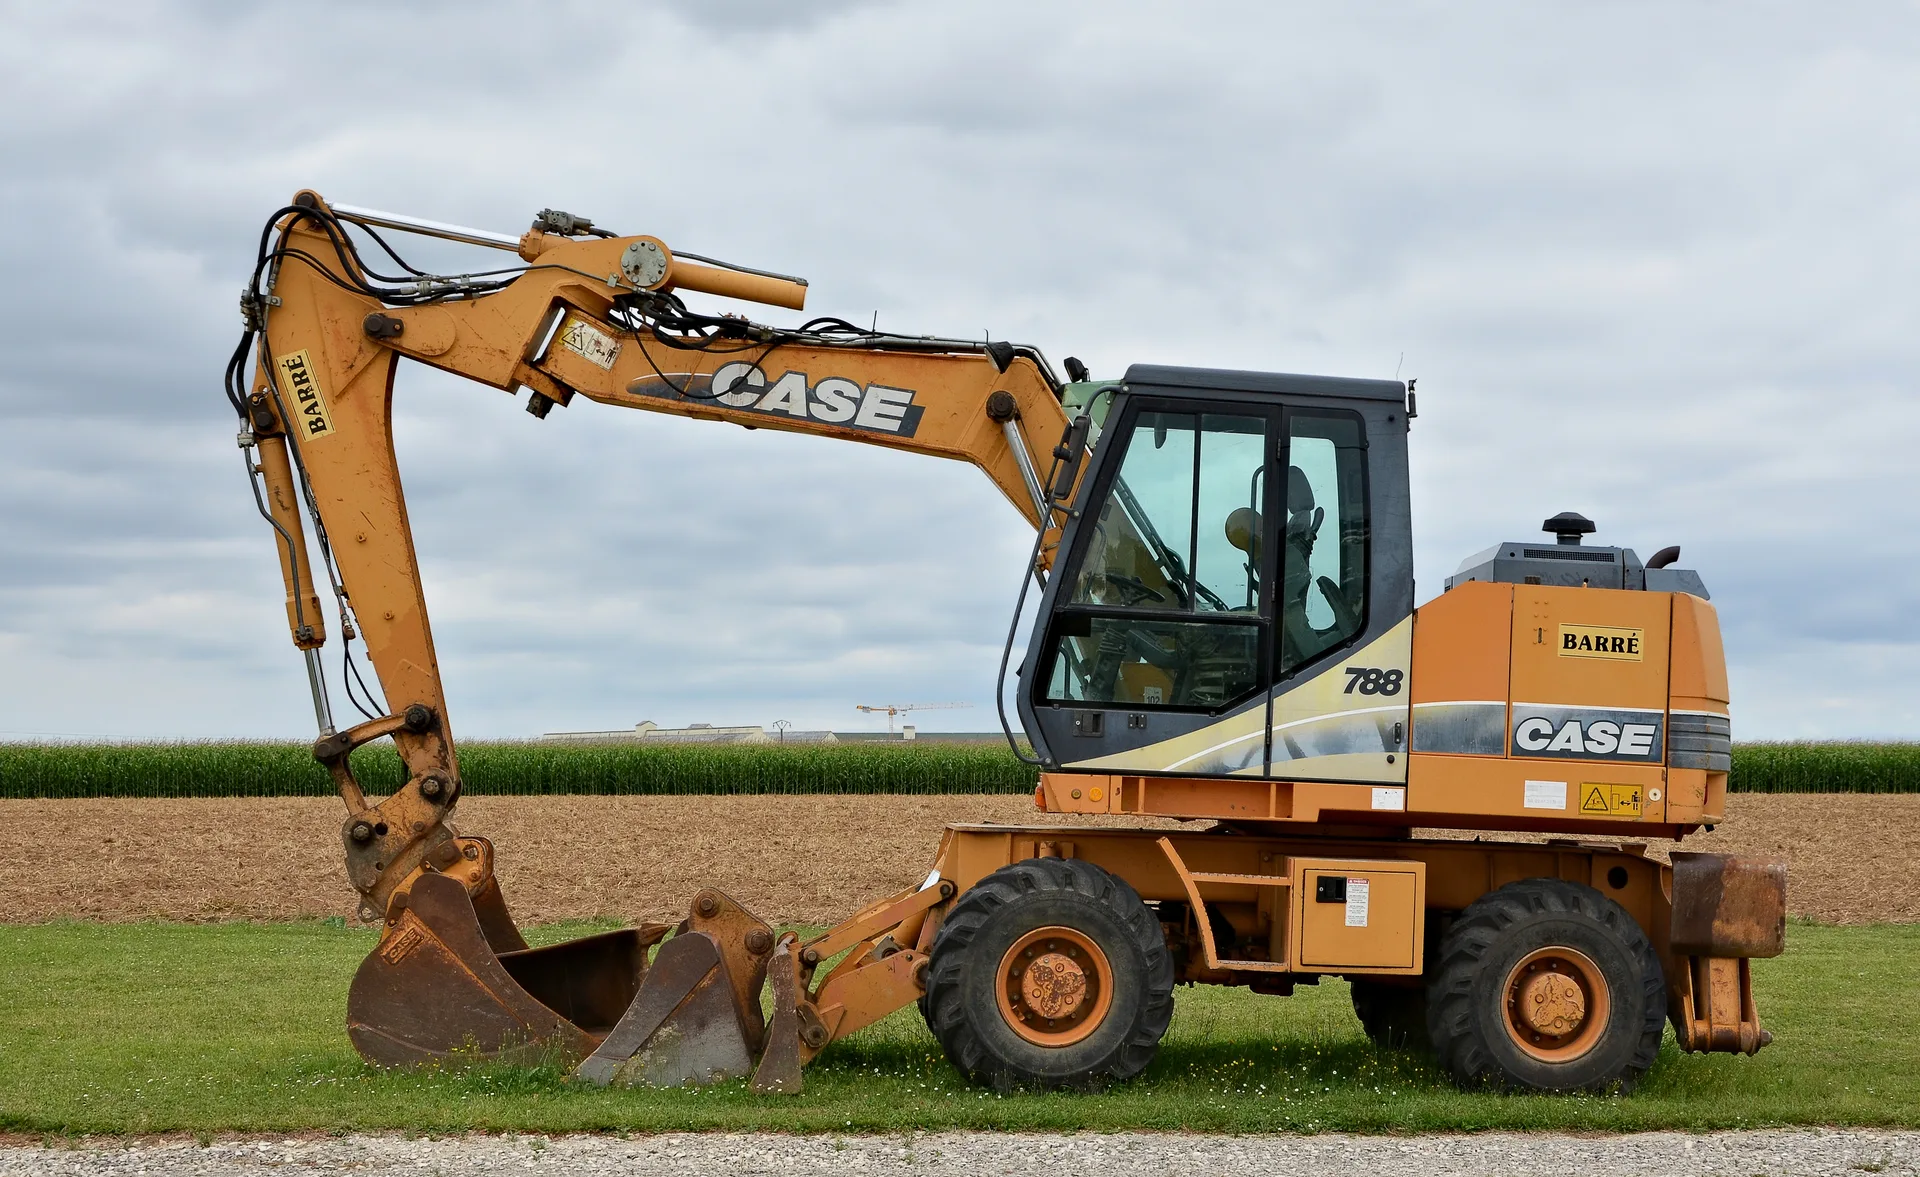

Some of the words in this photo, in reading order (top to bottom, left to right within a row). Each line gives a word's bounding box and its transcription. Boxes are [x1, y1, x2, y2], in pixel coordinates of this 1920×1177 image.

[282, 355, 327, 434] BARRÉ
[711, 362, 913, 432] CASE
[1563, 632, 1639, 654] BARRÉ
[1343, 667, 1404, 696] 788
[1515, 718, 1657, 755] CASE
[389, 928, 420, 958] CASE
